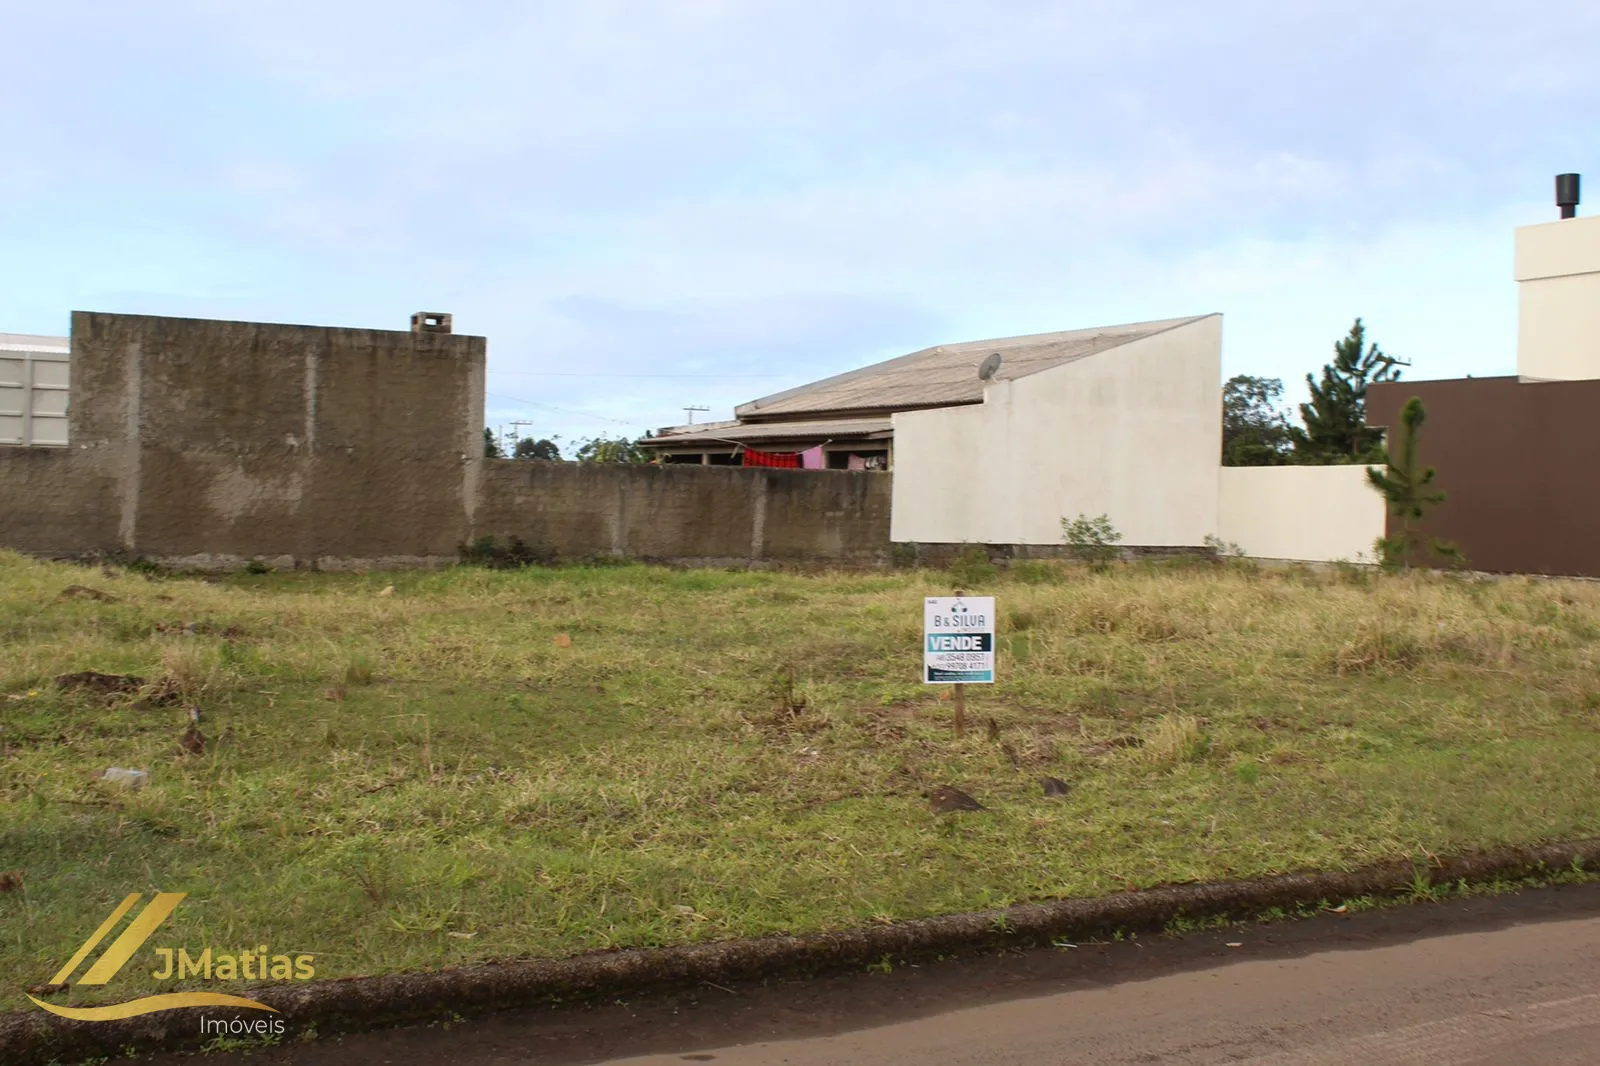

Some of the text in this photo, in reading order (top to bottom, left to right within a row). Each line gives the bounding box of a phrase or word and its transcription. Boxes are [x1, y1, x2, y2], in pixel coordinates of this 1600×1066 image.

[934, 615, 942, 627] B
[943, 617, 950, 627] &
[929, 636, 982, 651] VENDE
